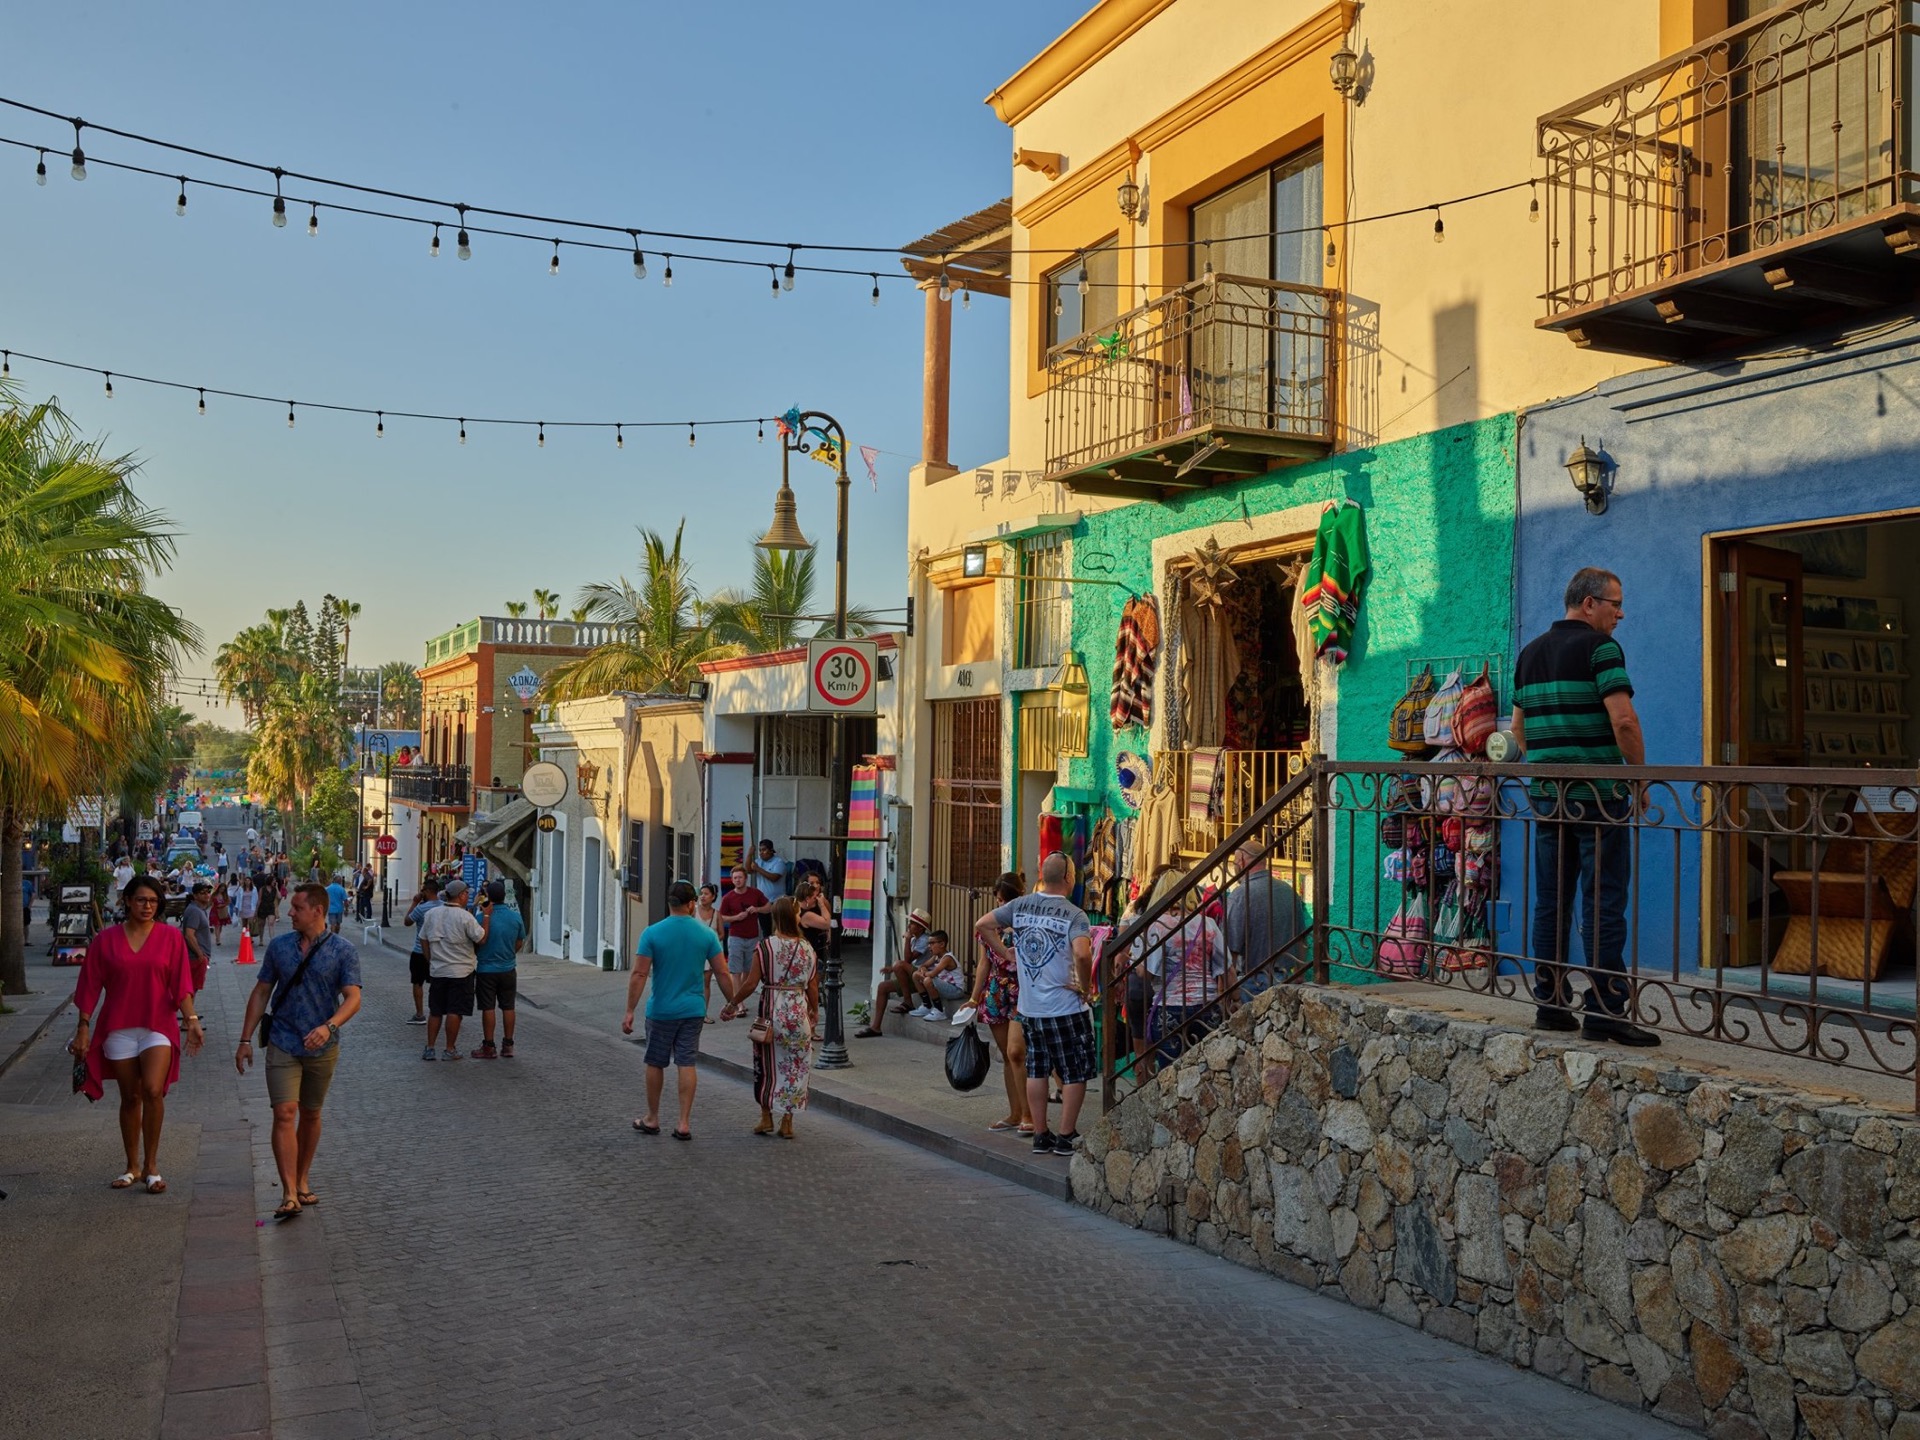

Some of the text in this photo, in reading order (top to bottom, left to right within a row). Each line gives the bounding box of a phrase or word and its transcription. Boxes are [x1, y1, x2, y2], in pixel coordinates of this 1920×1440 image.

[830, 656, 857, 679] 30
[827, 681, 858, 691] Km/h
[377, 841, 396, 850] ALTO
[1016, 903, 1071, 918] AMERICAN
